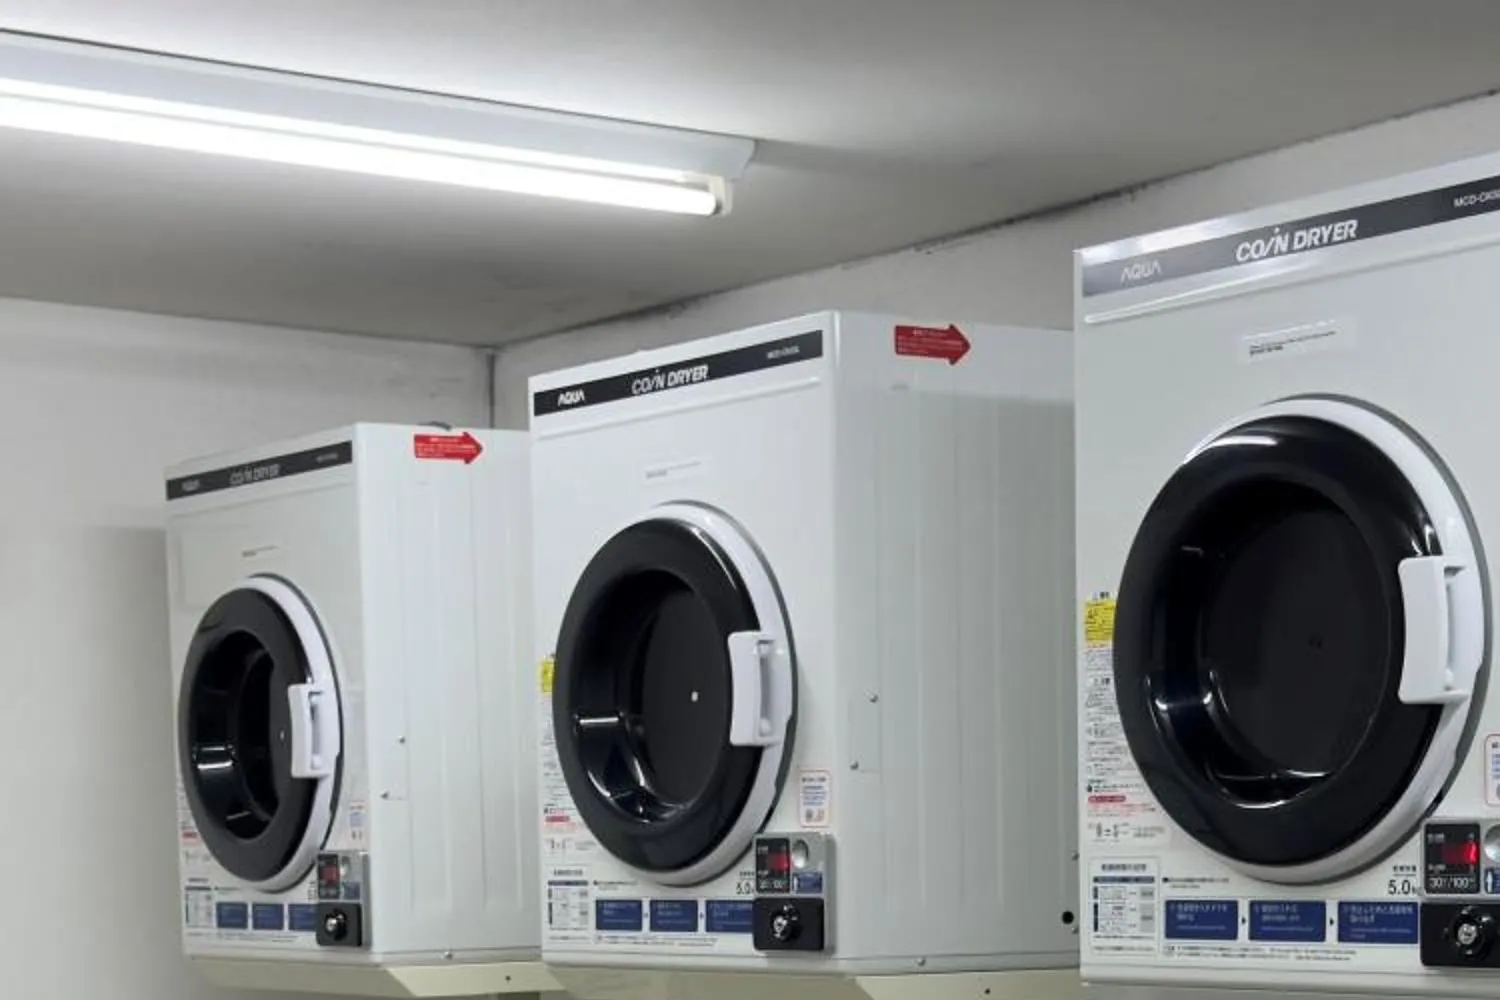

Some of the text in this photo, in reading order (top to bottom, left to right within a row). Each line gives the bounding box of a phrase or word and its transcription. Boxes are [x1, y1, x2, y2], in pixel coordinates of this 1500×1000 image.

[1120, 259, 1162, 282] AQUA
[1235, 226, 1289, 263] COIN
[1293, 219, 1358, 249] DRYER
[557, 389, 585, 406] AQUA
[667, 365, 709, 387] DRYER
